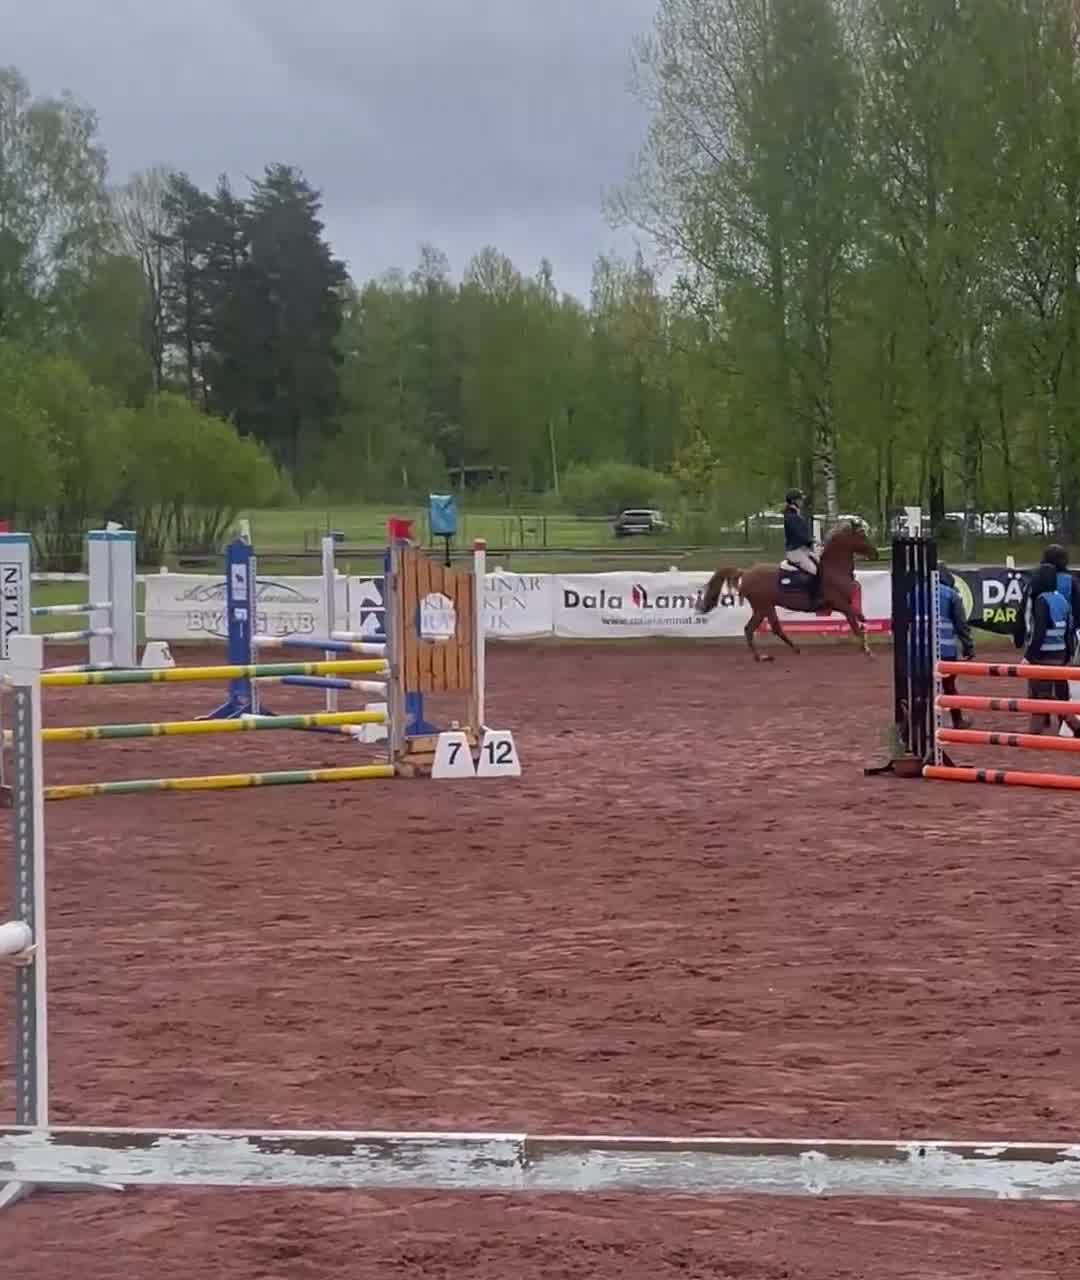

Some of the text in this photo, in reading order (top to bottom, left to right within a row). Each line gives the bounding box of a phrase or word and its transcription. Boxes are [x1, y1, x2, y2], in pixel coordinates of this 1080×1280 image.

[564, 590, 622, 609] Dala
[982, 572, 1024, 604] DÄ
[3, 567, 19, 657] YLEN
[983, 607, 1017, 623] PAR
[448, 742, 462, 765] 7
[484, 740, 513, 764] 12
